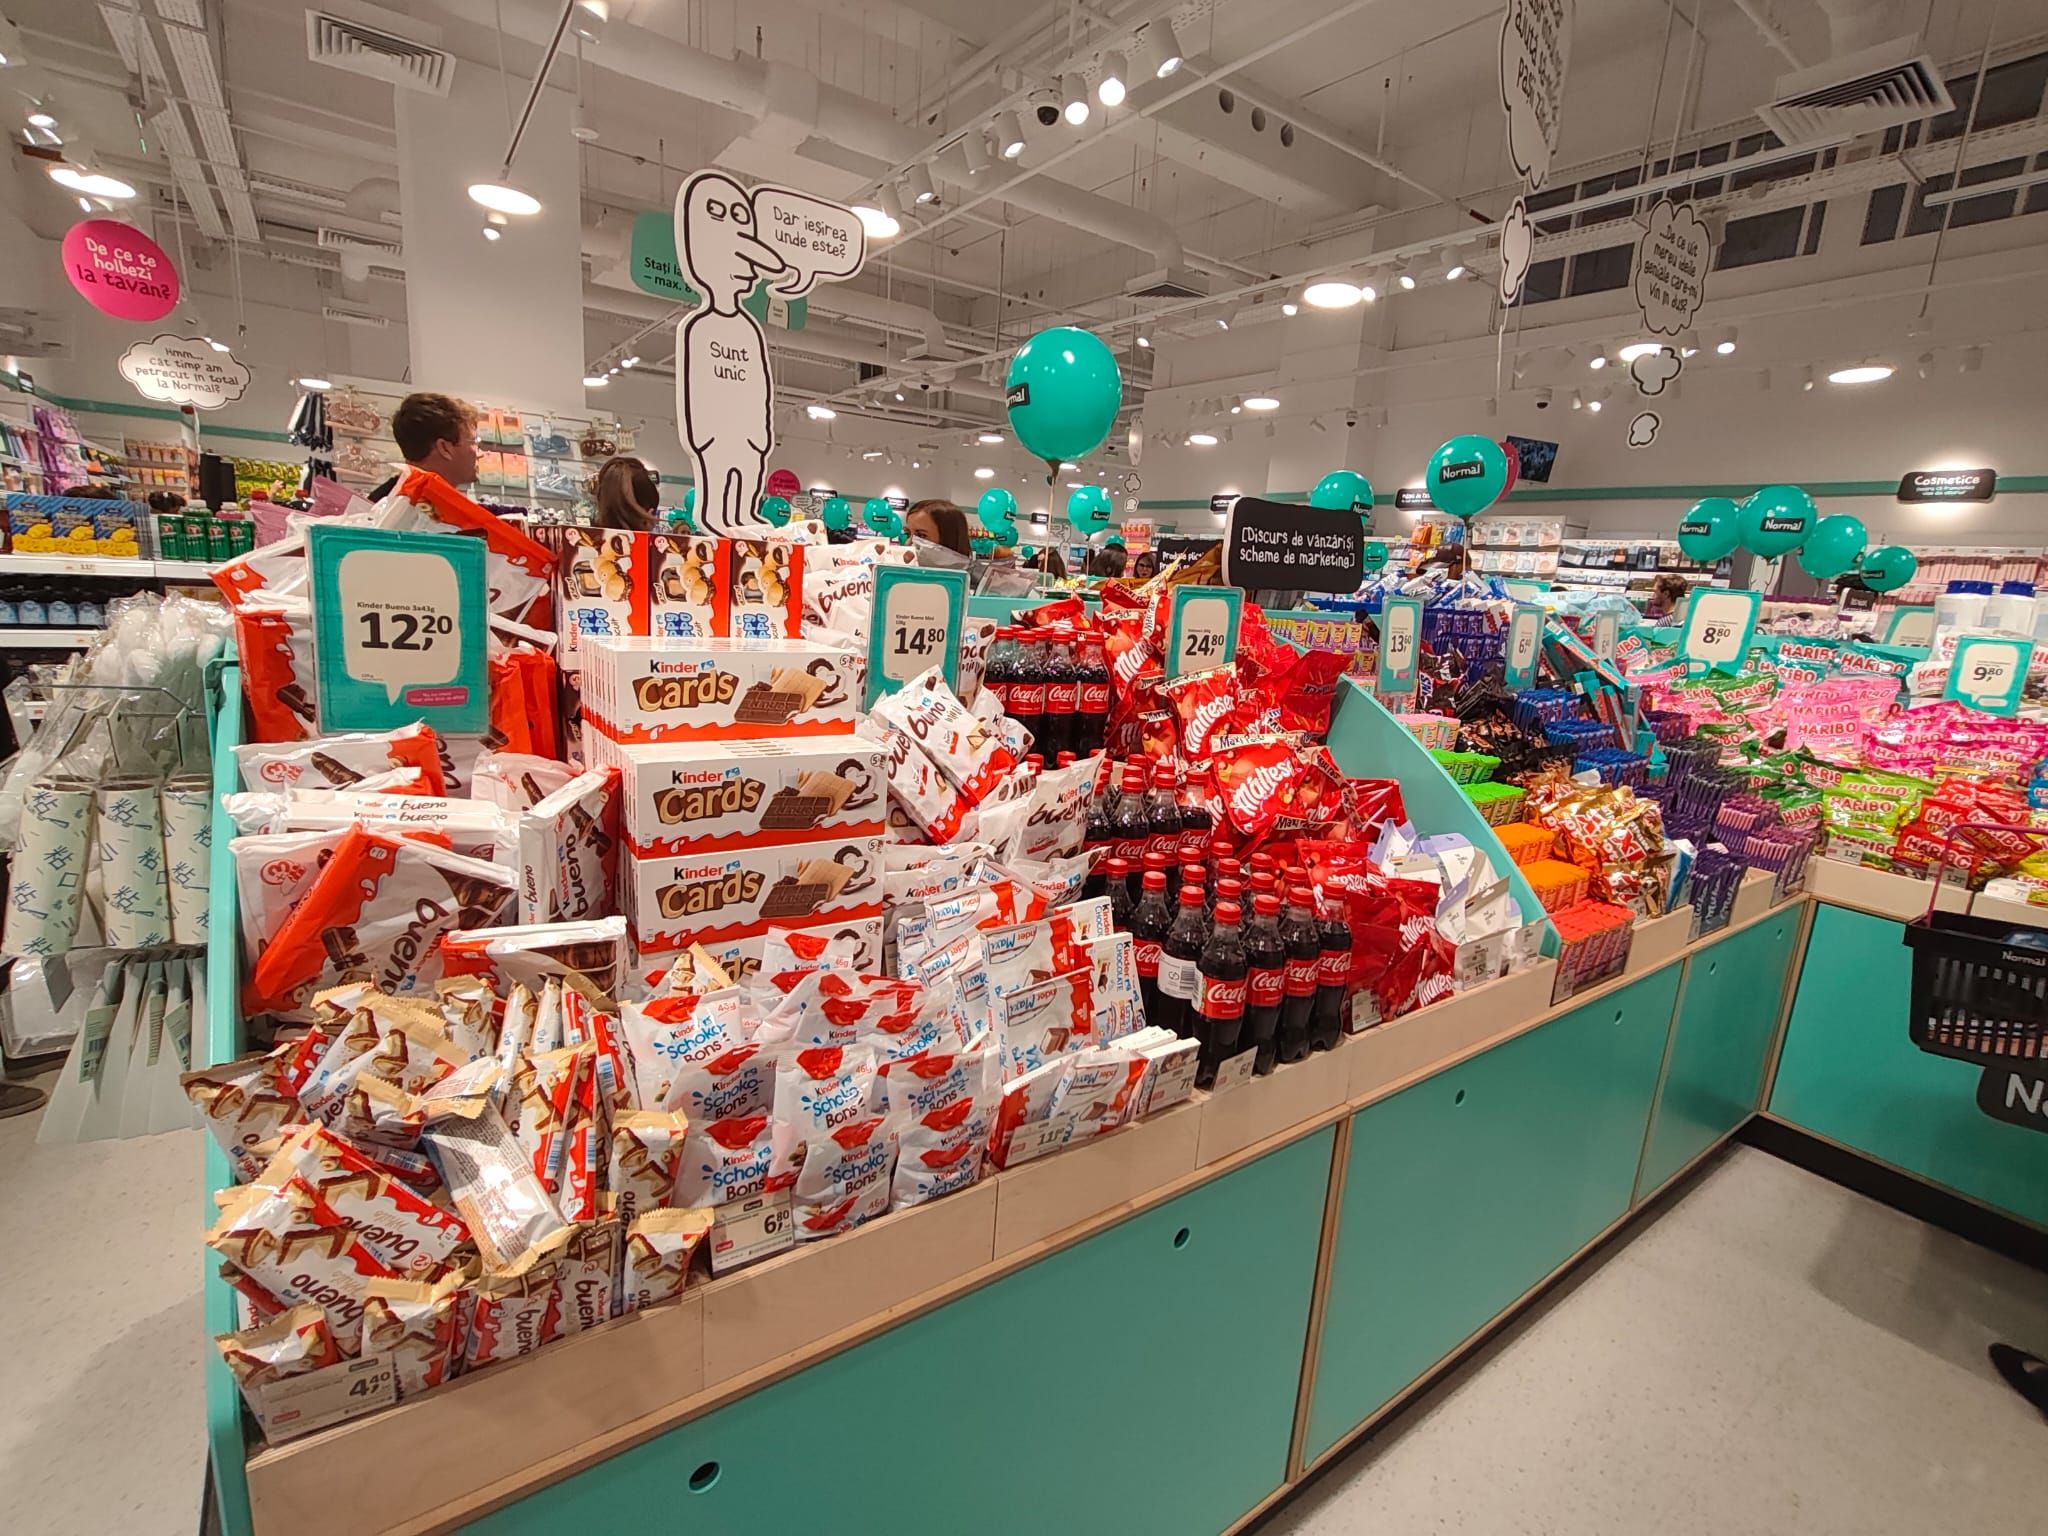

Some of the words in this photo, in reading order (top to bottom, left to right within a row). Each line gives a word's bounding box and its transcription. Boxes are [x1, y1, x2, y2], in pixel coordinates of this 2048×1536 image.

[773, 206, 800, 226] Dar
[804, 215, 849, 242] ieșirea
[85, 237, 108, 255] De
[114, 246, 134, 263] ce
[138, 249, 157, 268] te
[775, 229, 807, 248] unde
[812, 240, 847, 259] este?
[94, 253, 153, 281] holbezi
[644, 256, 672, 276] Stați
[77, 264, 97, 284] la
[103, 270, 171, 299] tavan?
[654, 275, 682, 292] max.
[709, 341, 750, 362] Sunt
[135, 366, 190, 380] petrecut
[208, 373, 240, 386] total
[174, 359, 202, 372] timp
[205, 364, 224, 373] am
[713, 365, 747, 382] unic
[156, 377, 169, 389] la
[172, 380, 221, 394] Normal?
[1442, 464, 1482, 480] Normal
[1914, 475, 1981, 486] Cosmetice
[1681, 524, 1709, 534] Normal
[1764, 518, 1803, 532] Normal
[1291, 532, 1304, 547] de
[1306, 534, 1345, 550] vânzări
[1239, 544, 1280, 562] scheme
[1283, 548, 1296, 565] de
[357, 602, 383, 610] Kinder
[385, 603, 411, 612] Bueno
[412, 604, 435, 614] 3x43g
[359, 611, 453, 652] 12,20
[567, 621, 578, 652] Kinder
[894, 626, 946, 656] 14,80
[1702, 626, 1731, 646] 8,80
[1185, 634, 1225, 657] 24,80
[650, 659, 699, 674] Kinder
[1972, 666, 2004, 682] 9,80
[638, 670, 736, 712] Cards
[1798, 722, 1856, 735] HARIBO
[1219, 735, 1243, 750] Maxi
[671, 770, 723, 785] Kinder
[1800, 762, 1843, 785] HARIB
[400, 799, 448, 811] bueno
[659, 777, 760, 825] Cards
[400, 811, 449, 822] bueno
[568, 833, 587, 918] bueno
[673, 864, 724, 881] Kinder
[527, 864, 538, 903] bueno
[905, 884, 942, 898] Kinder
[660, 870, 760, 919] Cards
[1115, 942, 1124, 993] CHOCOLATE
[1122, 940, 1132, 978] Kinder
[2002, 950, 2046, 967] Normal
[828, 1029, 858, 1040] Kinder
[814, 1080, 841, 1097] Kinder
[307, 1093, 336, 1115] Kinder
[714, 1092, 748, 1121] Bons
[825, 1105, 858, 1129] Bons
[722, 1150, 756, 1167] Kinder
[831, 1152, 890, 1184] Schoko-
[844, 1171, 878, 1195] Bons
[290, 1273, 364, 1329] bueno
